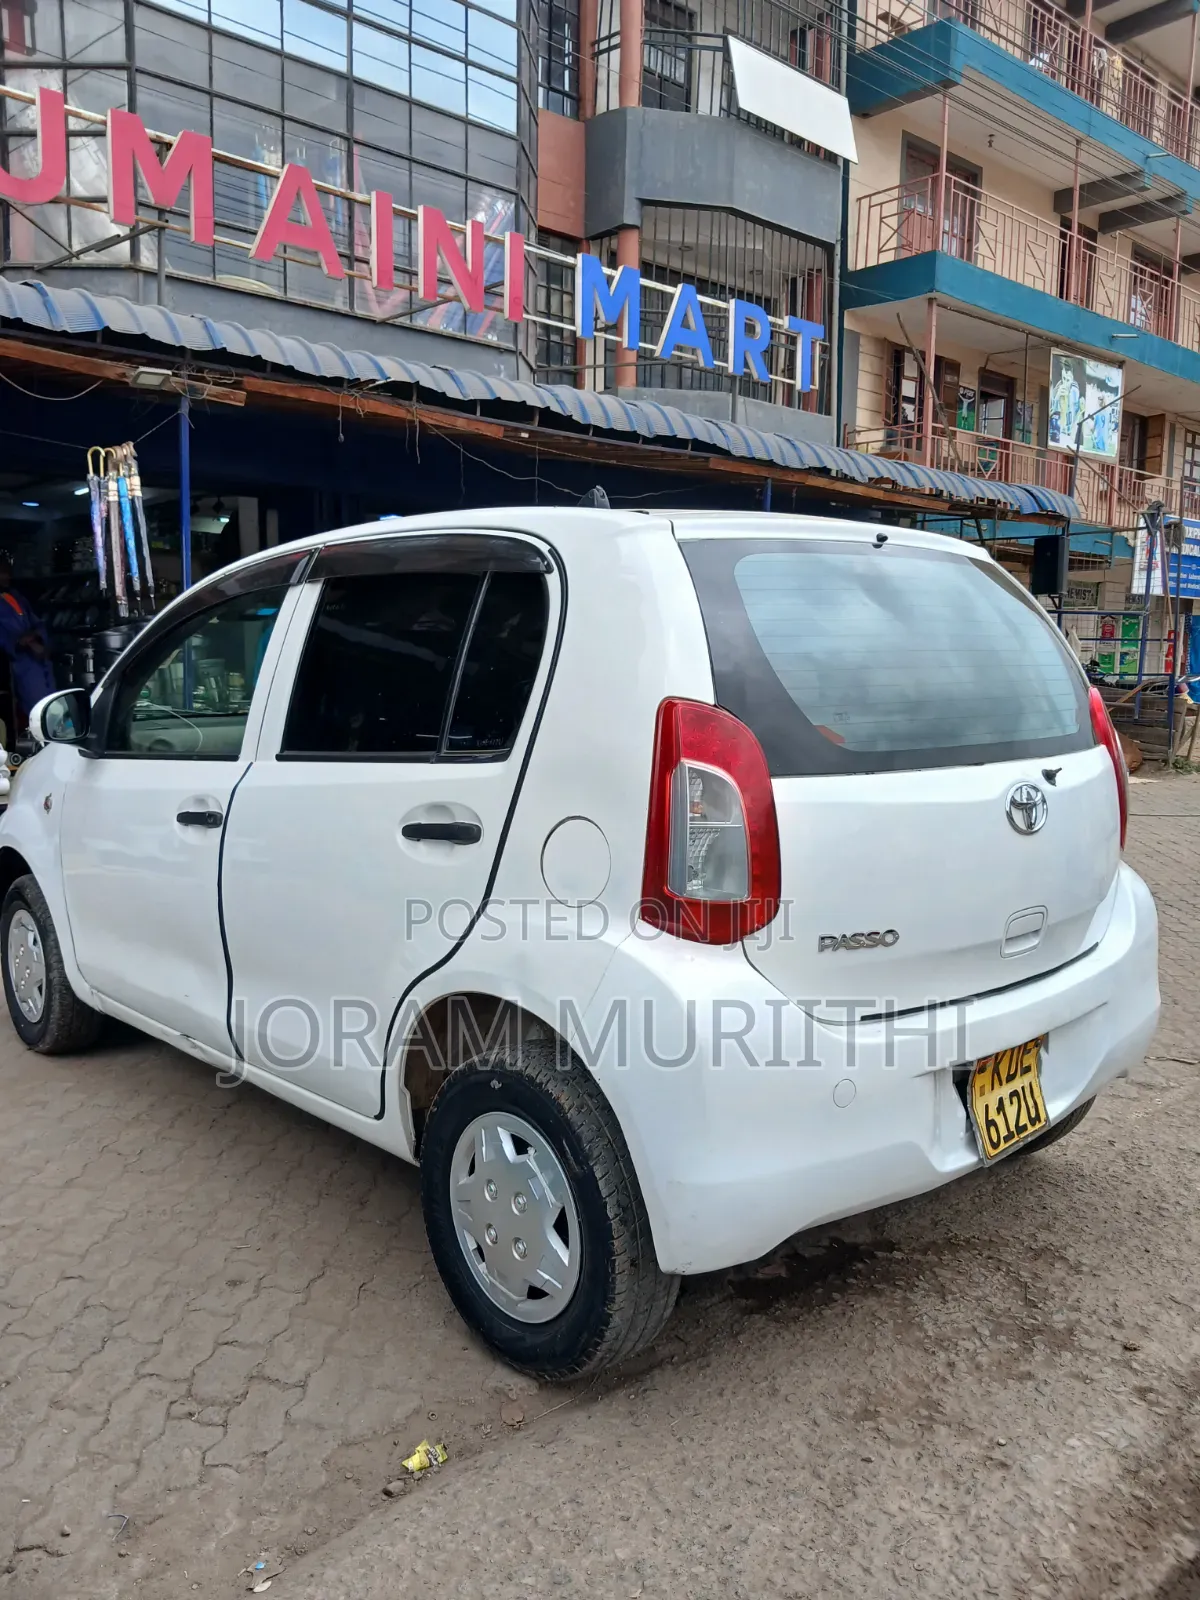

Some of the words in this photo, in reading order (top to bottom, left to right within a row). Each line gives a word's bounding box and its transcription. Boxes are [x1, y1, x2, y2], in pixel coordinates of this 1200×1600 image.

[575, 253, 825, 393] MART
[818, 929, 900, 952] PASSO
[984, 1081, 1042, 1151] 612U
